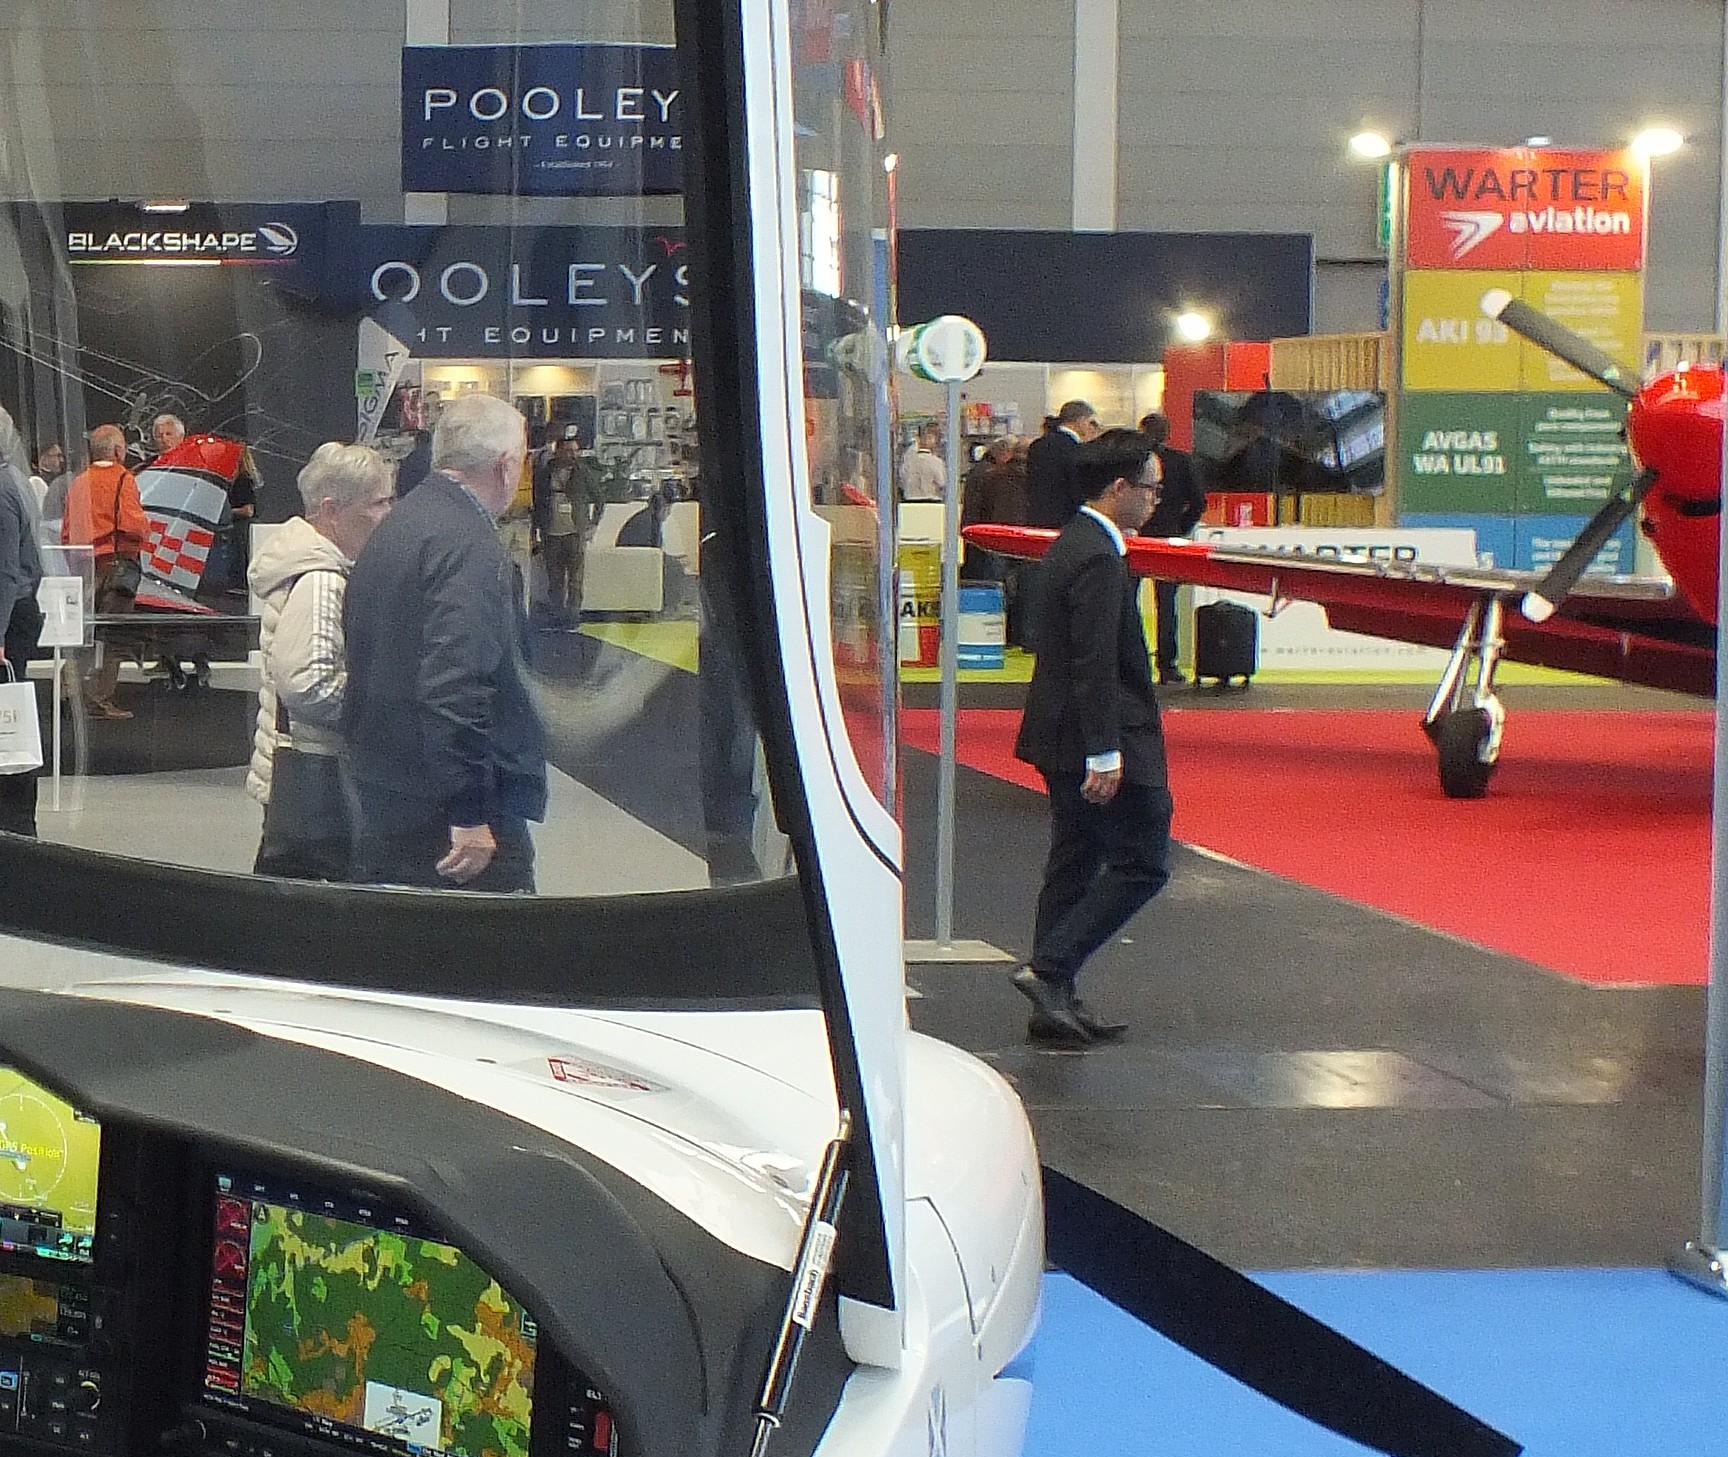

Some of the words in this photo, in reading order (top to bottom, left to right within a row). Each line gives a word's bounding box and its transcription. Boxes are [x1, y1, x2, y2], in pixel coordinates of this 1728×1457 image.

[421, 134, 532, 150] FLIGHT
[1423, 166, 1630, 202] WARTER
[1509, 206, 1630, 235] aviation
[67, 231, 257, 254] BLACKSHAPE
[1422, 430, 1499, 452] AVGAS
